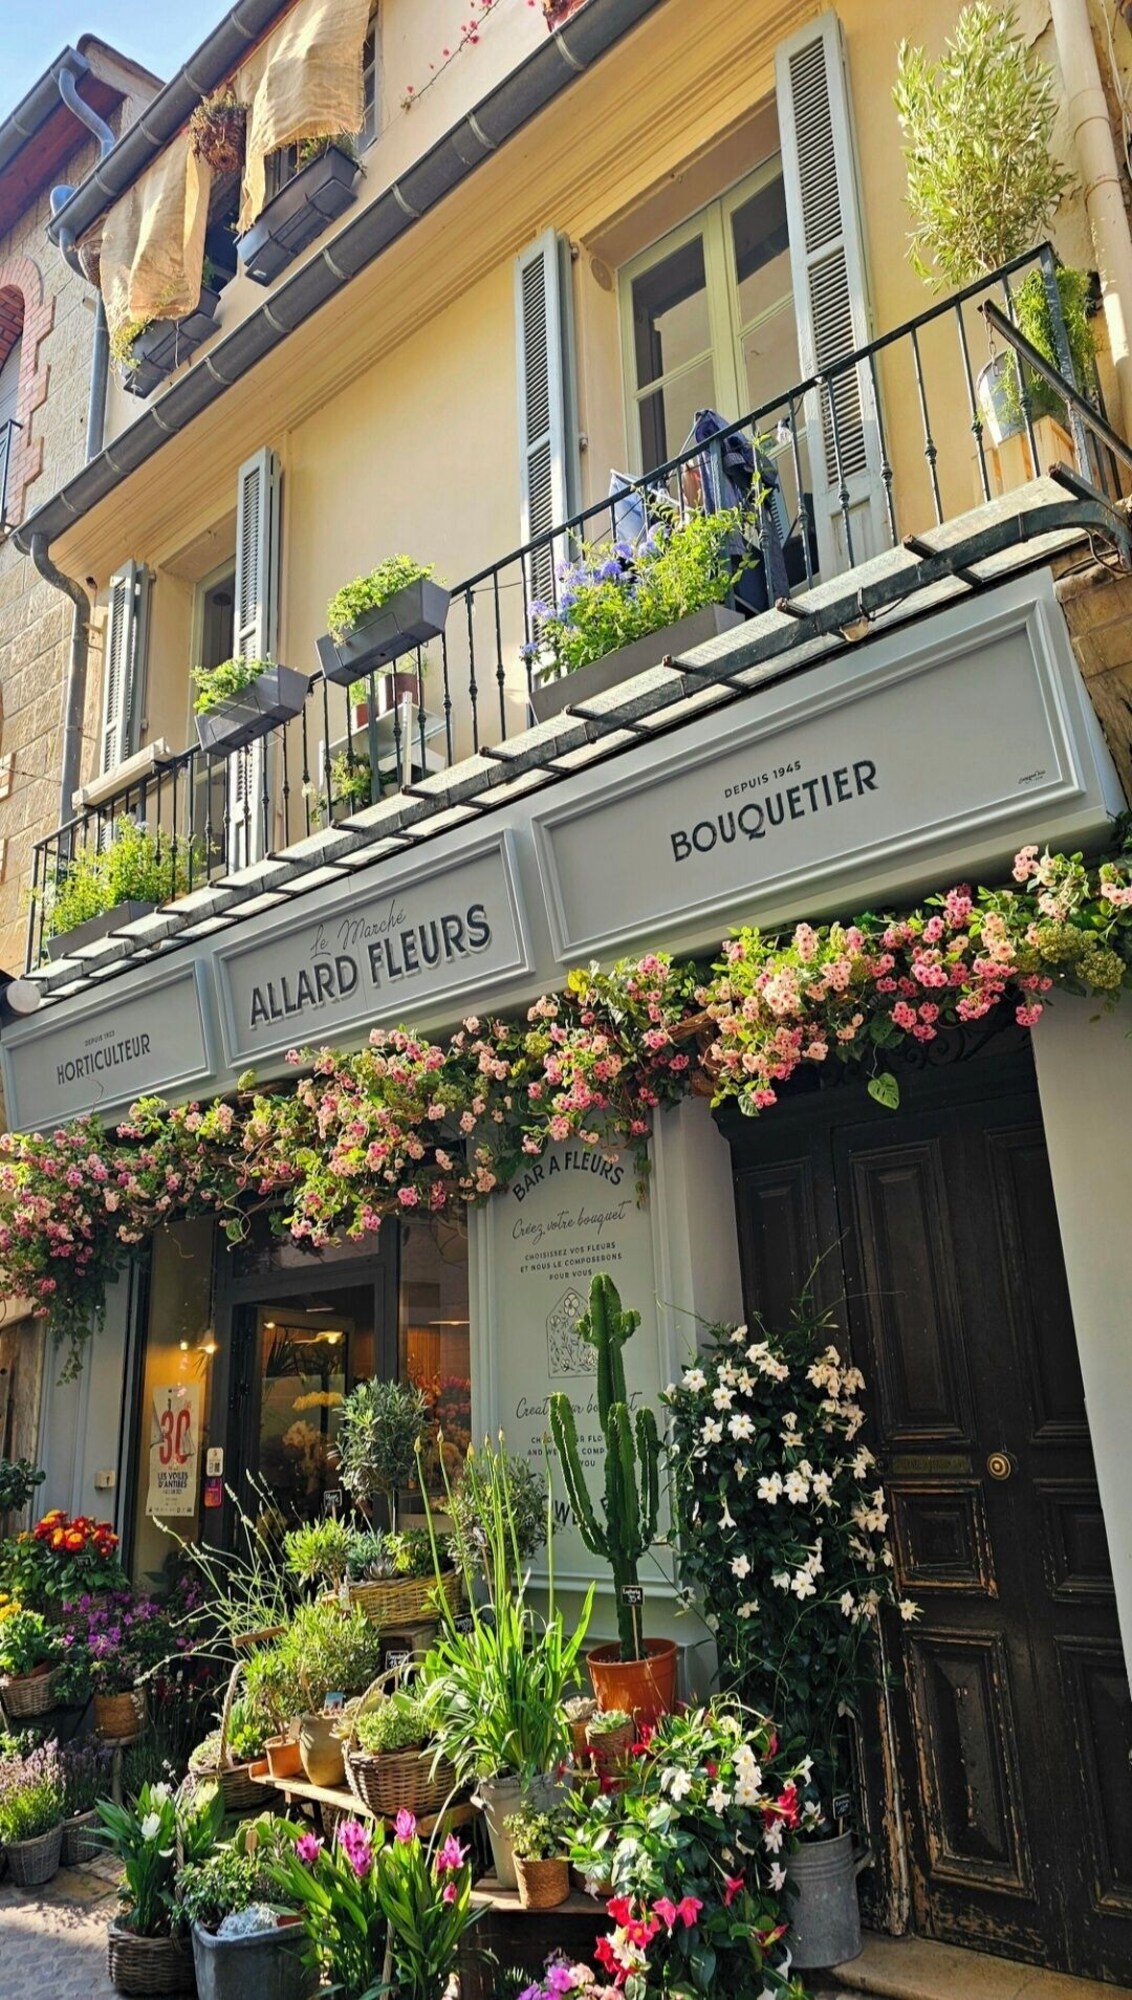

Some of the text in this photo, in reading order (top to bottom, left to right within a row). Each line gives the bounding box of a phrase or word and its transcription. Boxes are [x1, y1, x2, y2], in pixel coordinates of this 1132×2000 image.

[724, 760, 801, 798] DEPUIS 1945
[670, 760, 879, 862] BOUQUETIER
[310, 899, 407, 960] Le Marché
[250, 904, 491, 1027] ALLARD FLEURS
[57, 1033, 150, 1085] HORTICULTEUR
[512, 1164, 545, 1202] BAR
[564, 1151, 624, 1185] FLEURS
[547, 1211, 575, 1231] votre
[578, 1200, 632, 1235] bouquet
[520, 1265, 528, 1273] ET
[531, 1262, 551, 1271] NOUS
[564, 1252, 623, 1267] COMPOSERONS
[525, 1241, 616, 1261] CHOISISSEZ VOS FLEURS
[549, 1268, 593, 1280] POUR VOUS
[516, 1397, 551, 1419] Creat
[528, 1448, 543, 1456] AND
[581, 1447, 605, 1455] COMP
